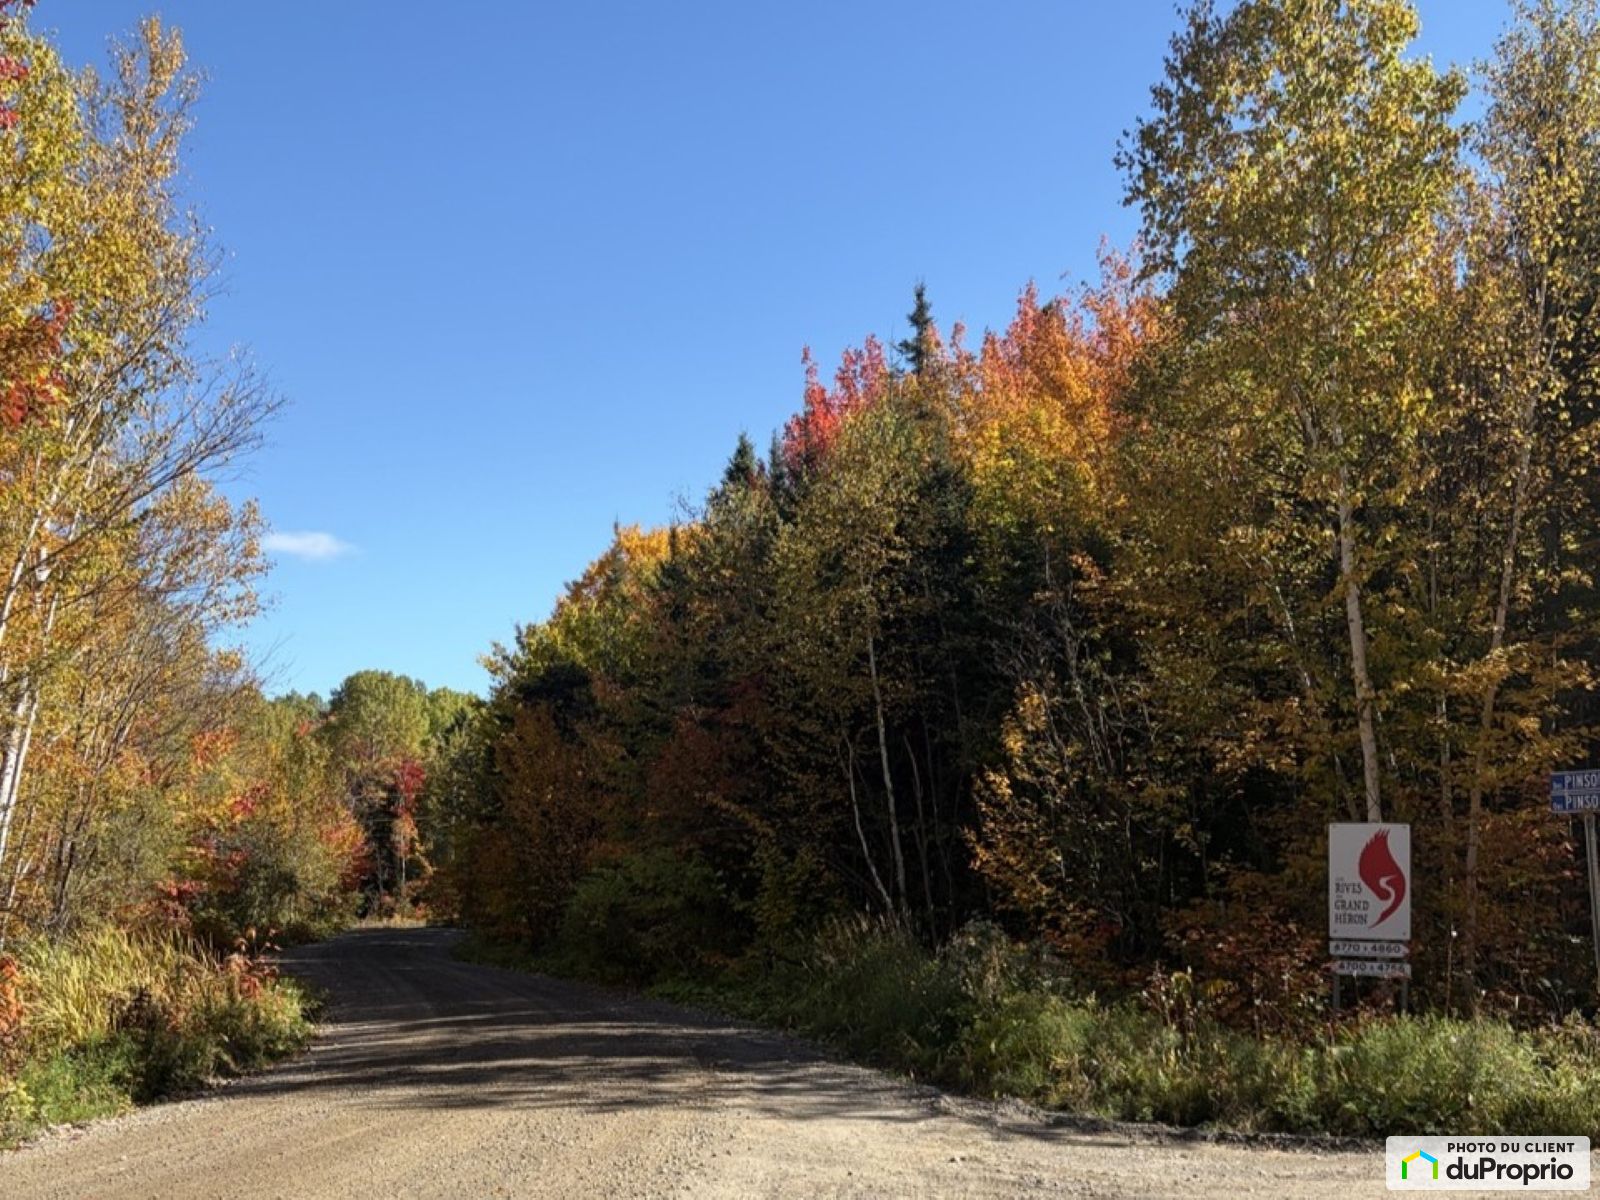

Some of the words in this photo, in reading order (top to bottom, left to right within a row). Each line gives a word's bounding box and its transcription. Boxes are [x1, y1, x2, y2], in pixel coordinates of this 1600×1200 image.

[1565, 795, 1600, 809] PINSO
[1335, 882, 1362, 894] RIVES
[1334, 900, 1369, 911] GRAND
[1334, 912, 1368, 925] HÉRON
